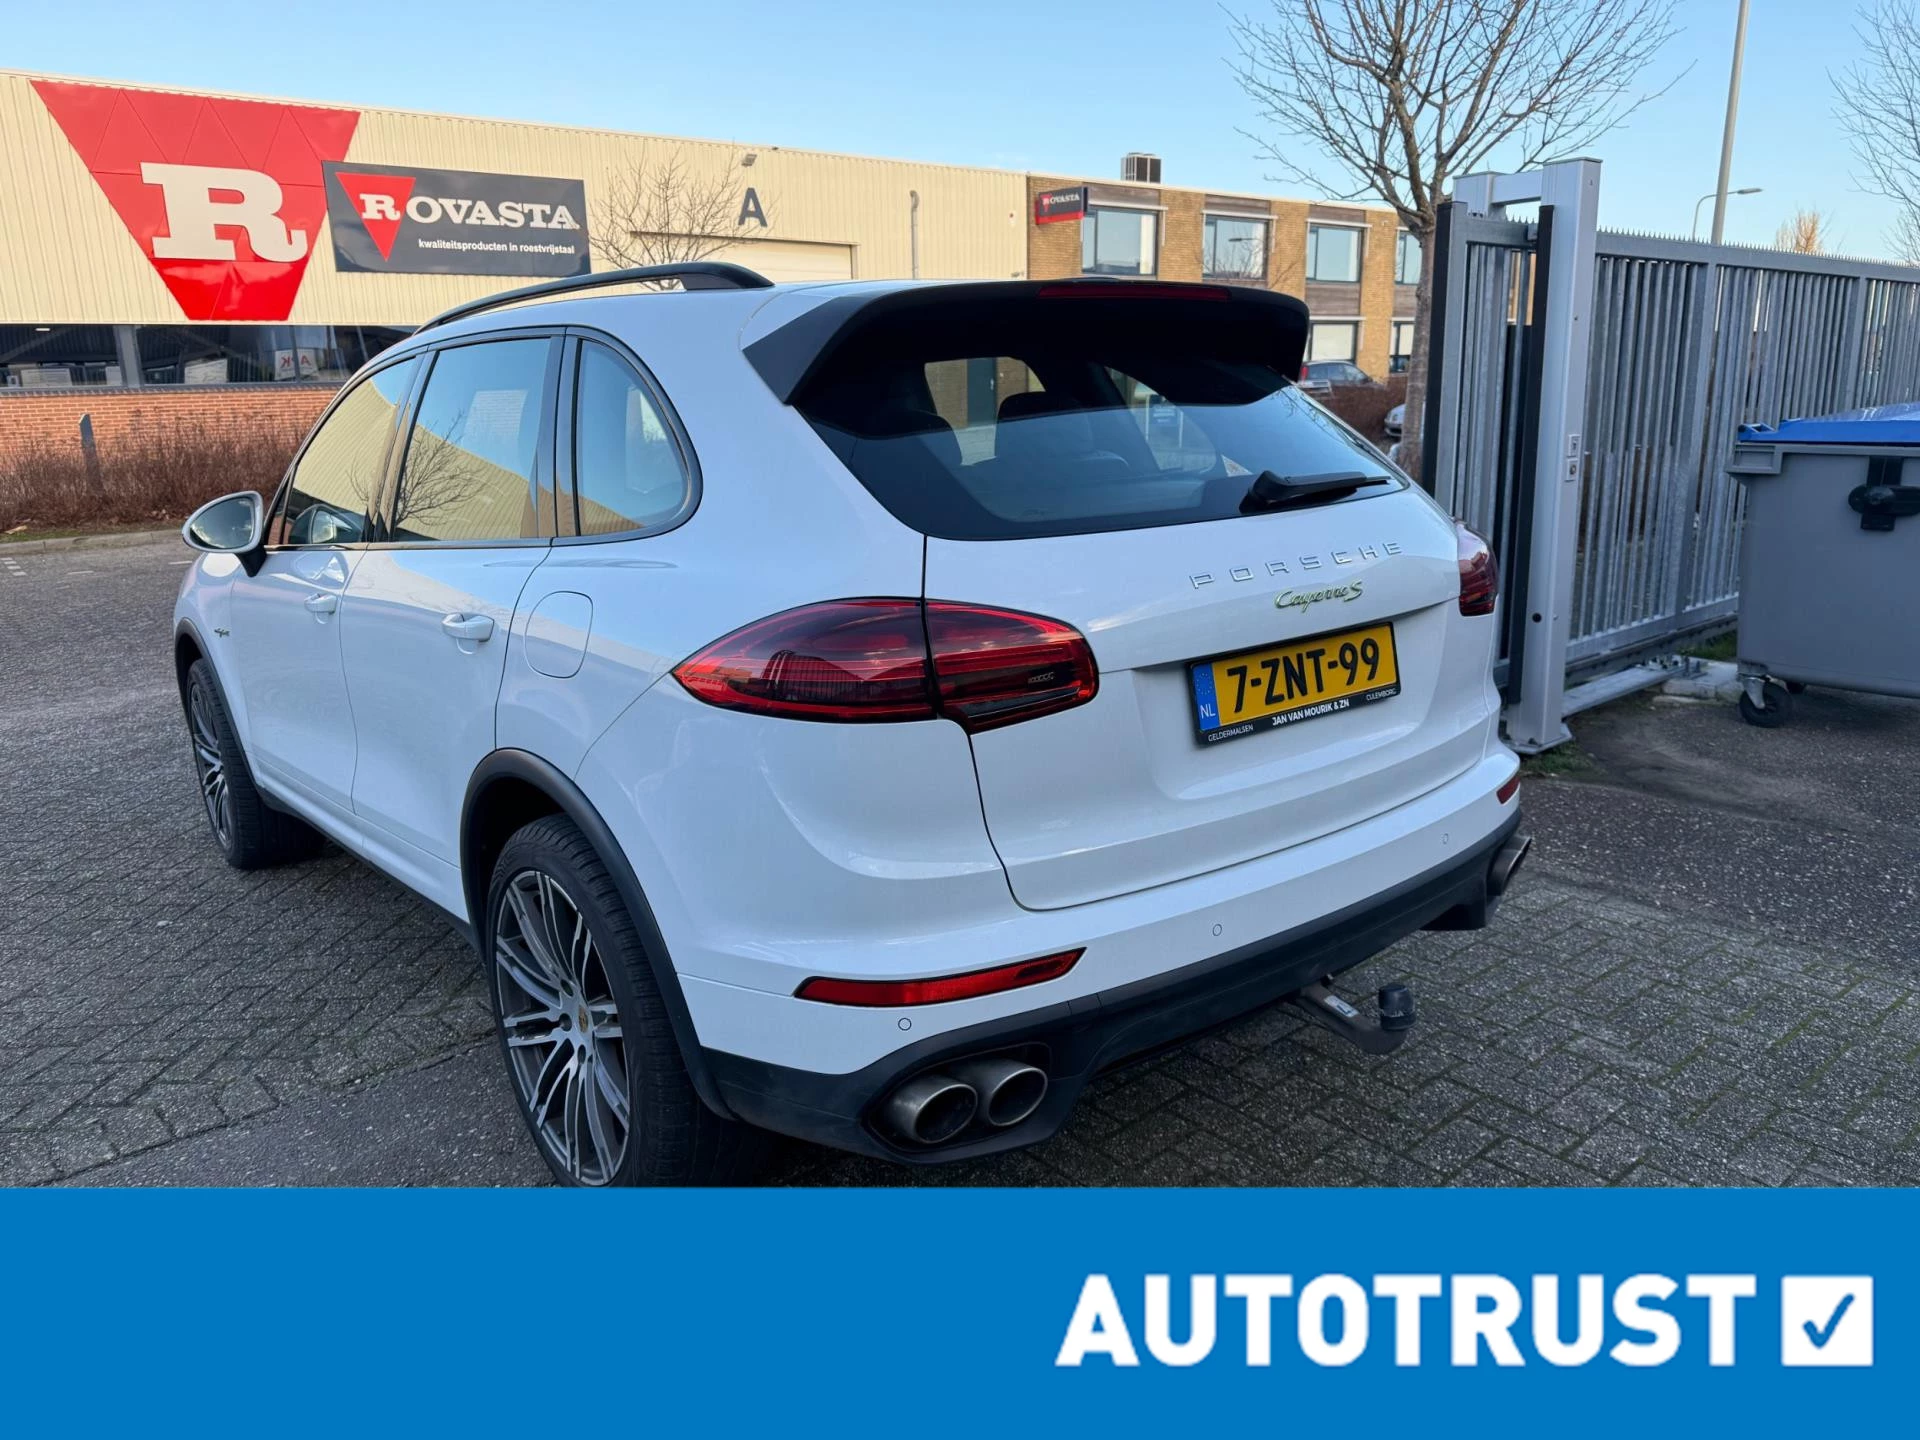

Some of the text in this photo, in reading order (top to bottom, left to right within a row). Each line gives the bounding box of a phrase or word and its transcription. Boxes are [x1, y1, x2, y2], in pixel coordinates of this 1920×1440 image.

[140, 162, 308, 262] R
[359, 193, 580, 230] ROVASTA
[738, 187, 768, 227] A
[418, 238, 575, 256] kwaliteitsproducten in roestvrijstaal
[1189, 542, 1402, 590] PORSCHE
[1274, 580, 1364, 613] Cayenne S
[1226, 638, 1380, 713] 7-ZNT-99
[1200, 703, 1216, 719] NL
[1272, 698, 1350, 726] JAN VAN MOURIK & ZN
[1207, 724, 1254, 742] GELDERMALSEN
